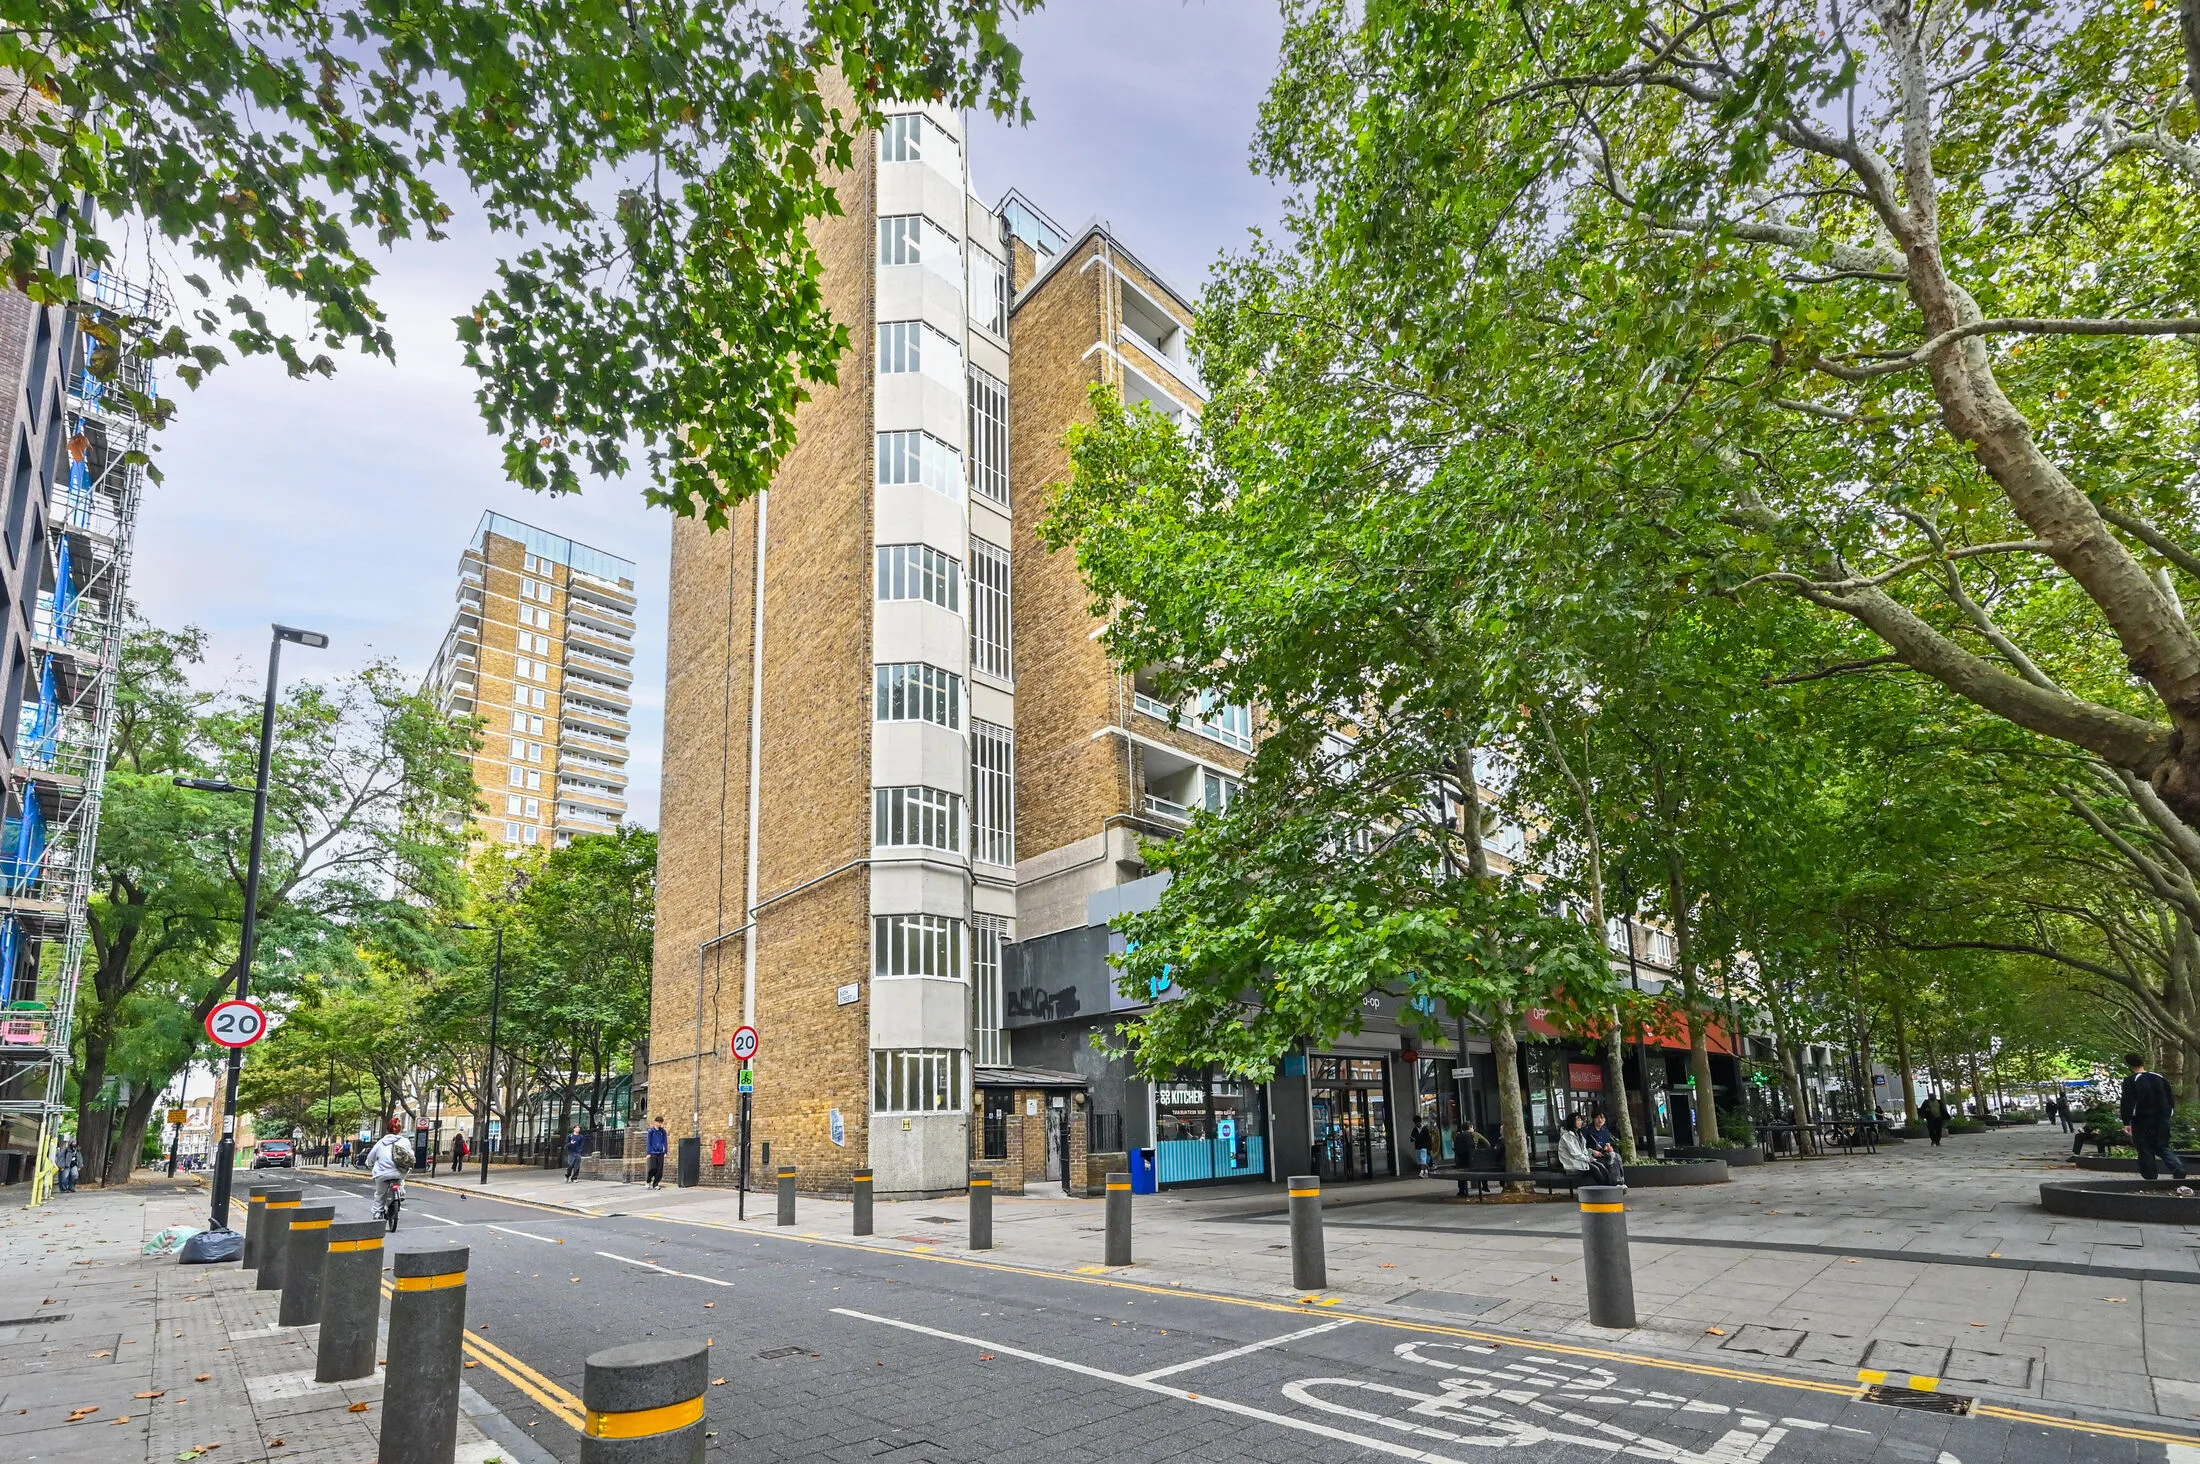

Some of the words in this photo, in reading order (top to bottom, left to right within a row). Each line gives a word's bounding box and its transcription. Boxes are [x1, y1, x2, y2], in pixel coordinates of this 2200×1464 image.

[1362, 997, 1380, 1010] o-op
[216, 1013, 258, 1034] 20
[735, 1035, 755, 1051] 20
[1171, 1090, 1204, 1104] KITCHEN
